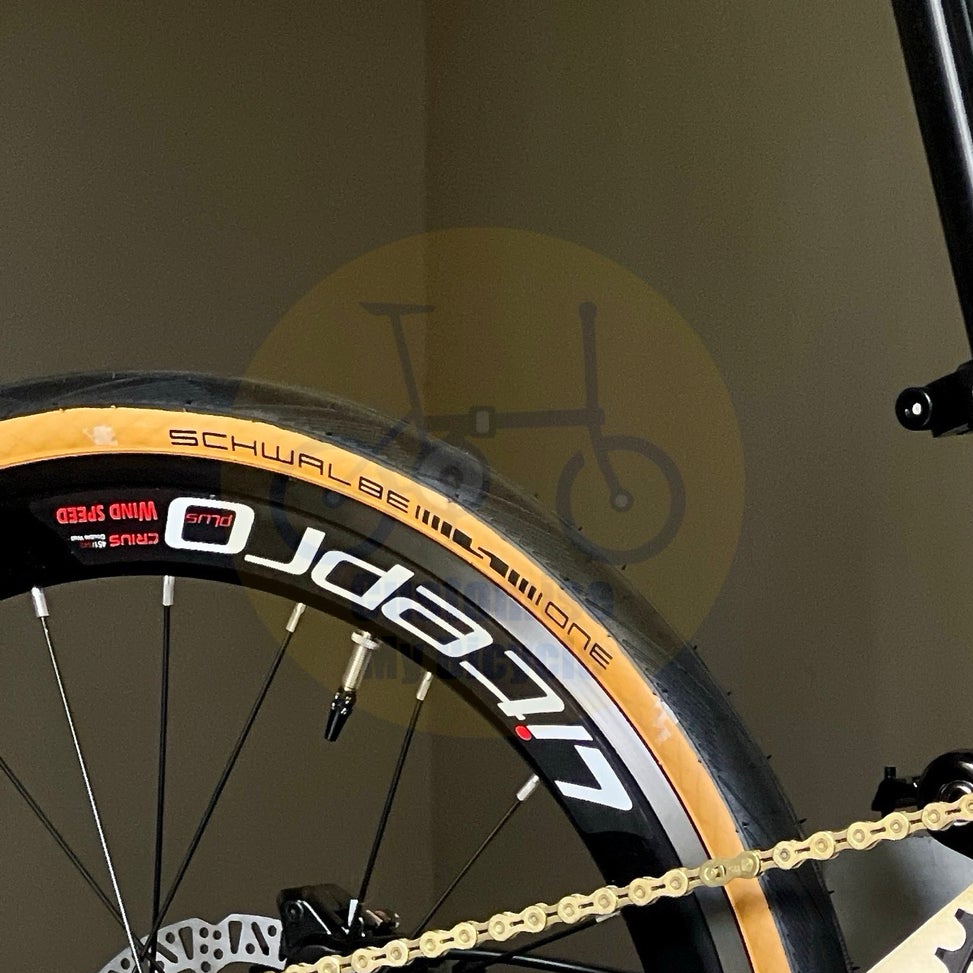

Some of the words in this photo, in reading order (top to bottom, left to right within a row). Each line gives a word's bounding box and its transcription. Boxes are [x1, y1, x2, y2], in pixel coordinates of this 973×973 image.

[56, 504, 105, 524] SPEED
[109, 532, 159, 547] CRIUS
[169, 429, 410, 514] SCHWALBE
[544, 600, 614, 670] ONE
